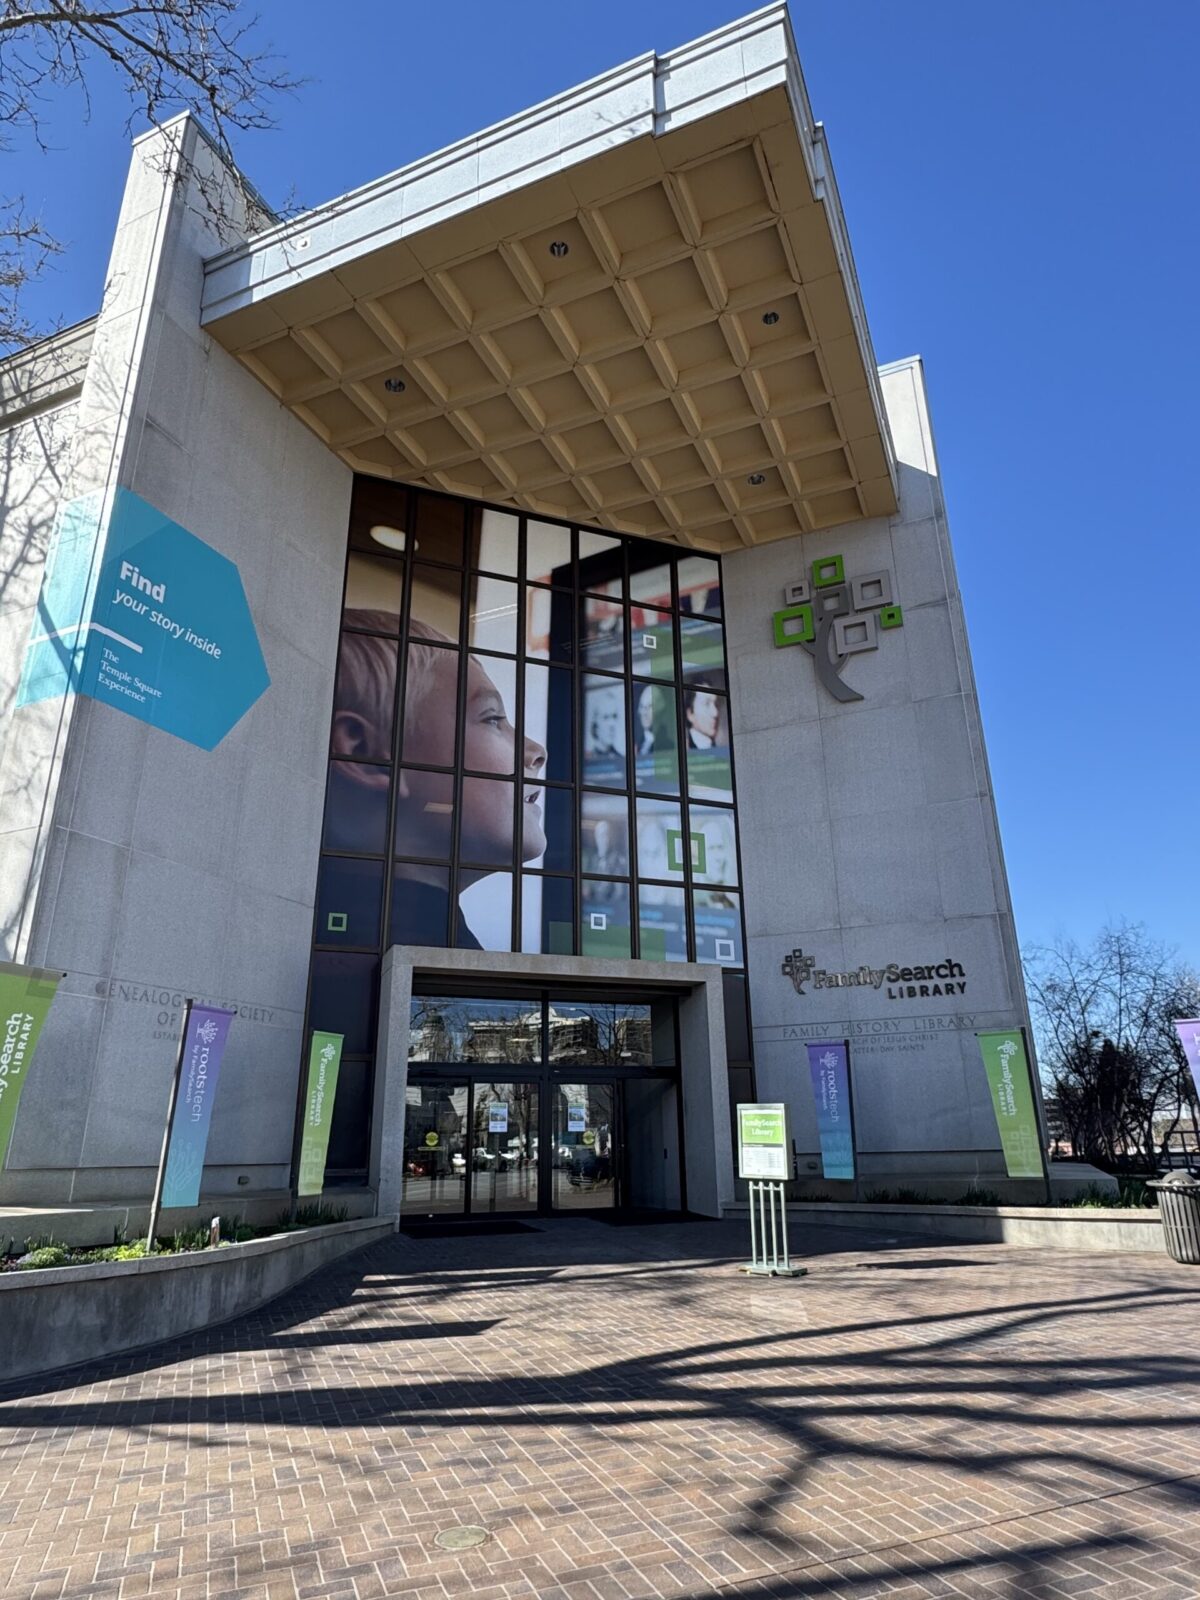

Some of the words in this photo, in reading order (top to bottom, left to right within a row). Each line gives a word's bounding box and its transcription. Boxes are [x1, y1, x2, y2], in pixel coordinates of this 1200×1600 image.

[119, 561, 167, 604] Find
[112, 589, 149, 616] your
[149, 608, 185, 639] story
[184, 628, 222, 660] inside
[102, 647, 120, 664] The
[97, 672, 146, 703] Experience
[100, 660, 132, 684] Temple
[134, 676, 163, 698] Square
[813, 958, 966, 989] FamilySearch
[887, 982, 967, 1000] LIBRARY
[157, 1011, 177, 1027] OF
[783, 1025, 830, 1039] FAMILY
[841, 1021, 901, 1035] HISTORY
[914, 1015, 977, 1031] LIBRARY
[0, 1012, 23, 1099] ySearch
[11, 1013, 34, 1074] LIBRARY
[184, 1055, 198, 1104] FamilySearch
[191, 1047, 210, 1122] rootstech
[314, 1058, 329, 1126] FamilySearch
[827, 1070, 840, 1122] rootstech
[1000, 1054, 1018, 1116] FamilySearch
